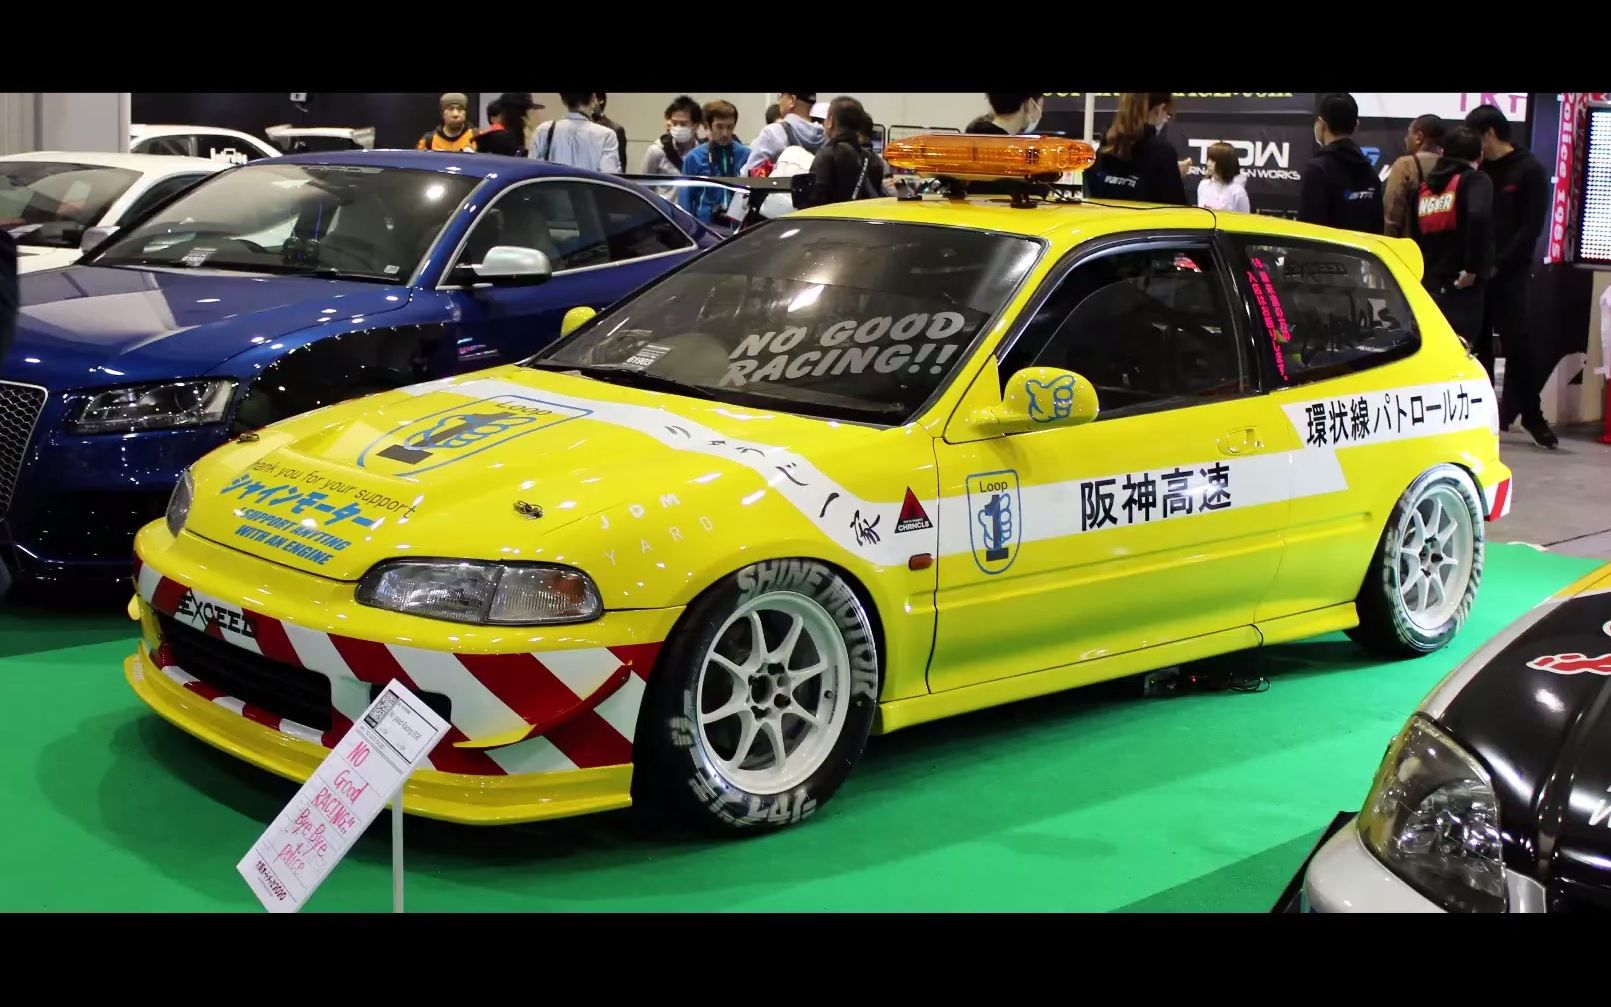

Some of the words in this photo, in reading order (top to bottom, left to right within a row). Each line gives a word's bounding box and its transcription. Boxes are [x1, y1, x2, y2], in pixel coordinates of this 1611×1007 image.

[1257, 169, 1301, 180] WORKS
[728, 326, 808, 359] NO
[819, 311, 966, 347] GOOD
[716, 344, 959, 387] RACING!!
[496, 400, 553, 416] Loop
[1304, 384, 1483, 448] 環状線パトロールカー
[273, 467, 304, 480] you
[301, 470, 326, 484] for
[319, 480, 358, 494] your
[354, 489, 417, 519] support
[979, 481, 1008, 493] Loop
[1080, 462, 1232, 532] 阪神高速
[244, 508, 298, 531] SUPPORT
[235, 525, 272, 542] WITH
[264, 534, 289, 548] AN
[282, 541, 335, 565] ENGINE
[736, 558, 830, 606] SHINE
[178, 587, 257, 639] EXCEED
[346, 741, 370, 768] NO
[333, 769, 369, 805] Good
[292, 808, 313, 836] Bye
[303, 823, 328, 857] Bye
